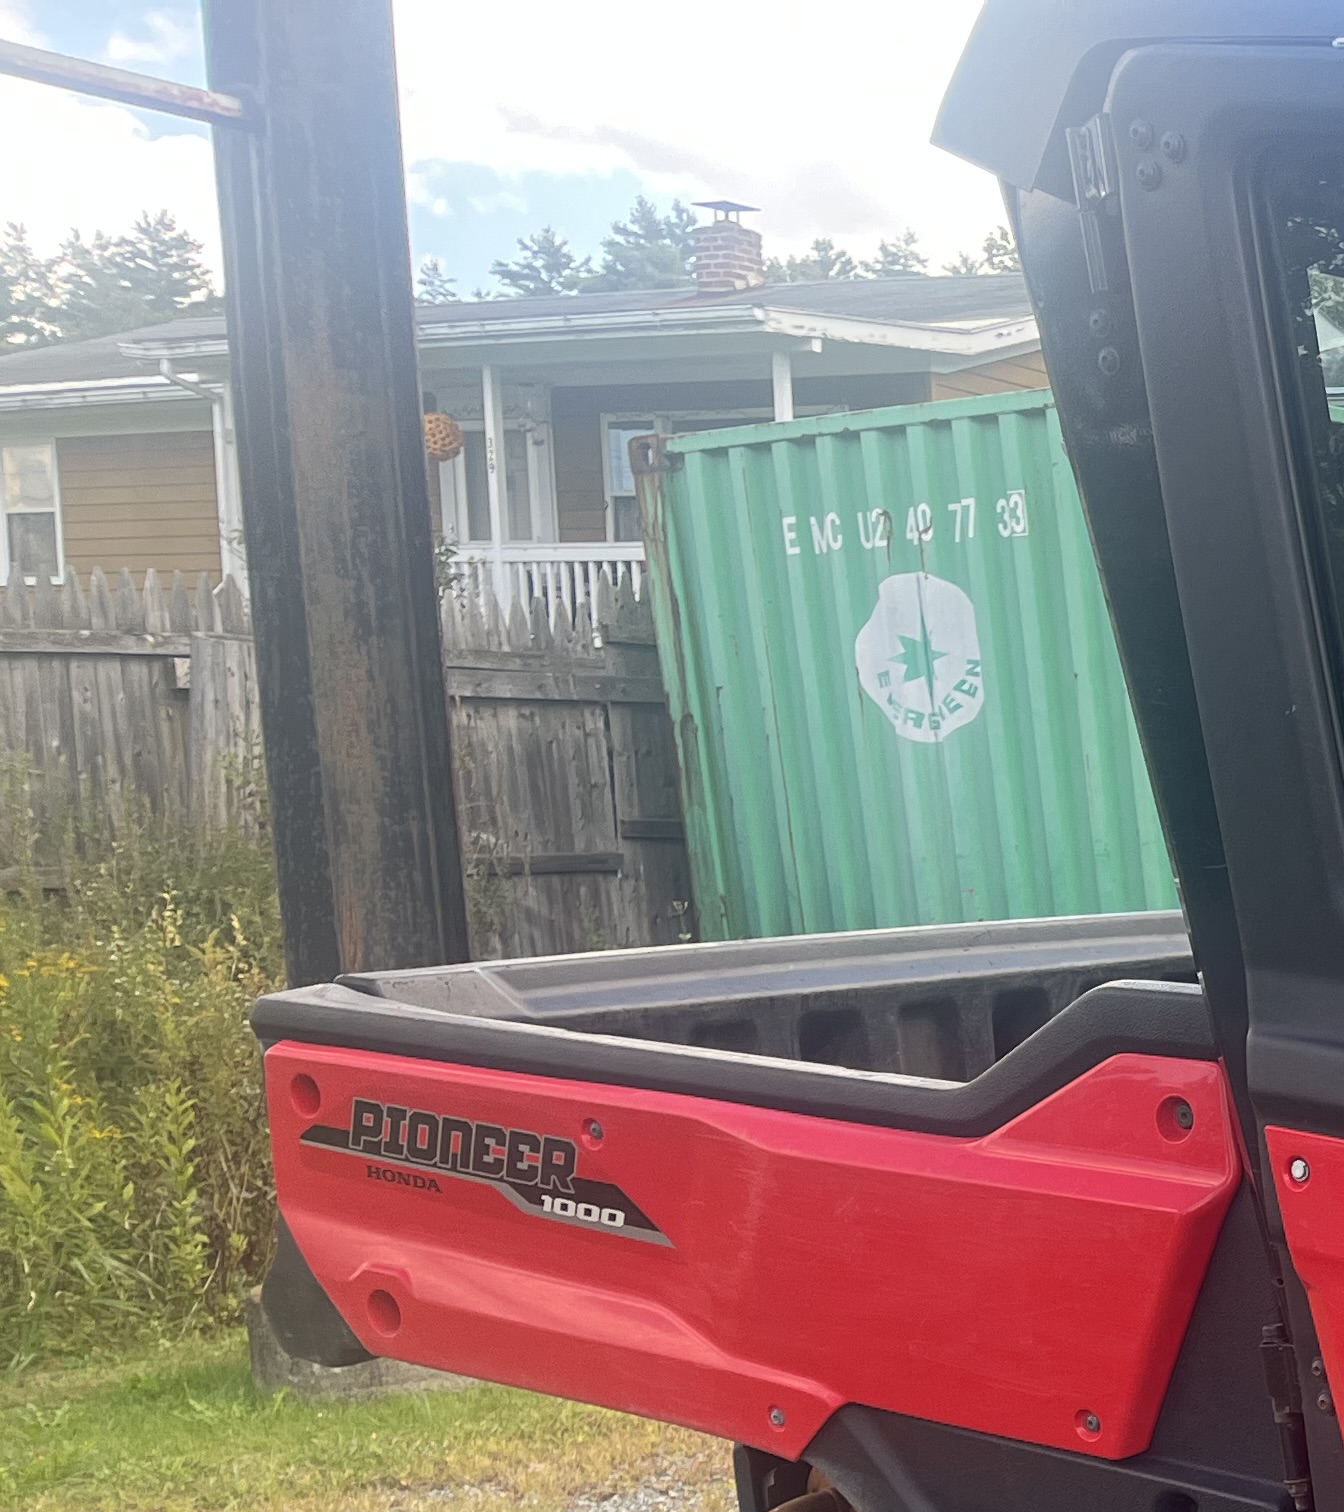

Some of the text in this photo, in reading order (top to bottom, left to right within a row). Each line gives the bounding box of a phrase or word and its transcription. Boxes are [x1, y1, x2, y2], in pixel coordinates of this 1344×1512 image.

[948, 497, 976, 543] 77
[996, 493, 1026, 538] 33
[349, 1097, 577, 1193] PIONEER
[366, 1165, 443, 1194] HONDA
[541, 1194, 625, 1228] 1000
